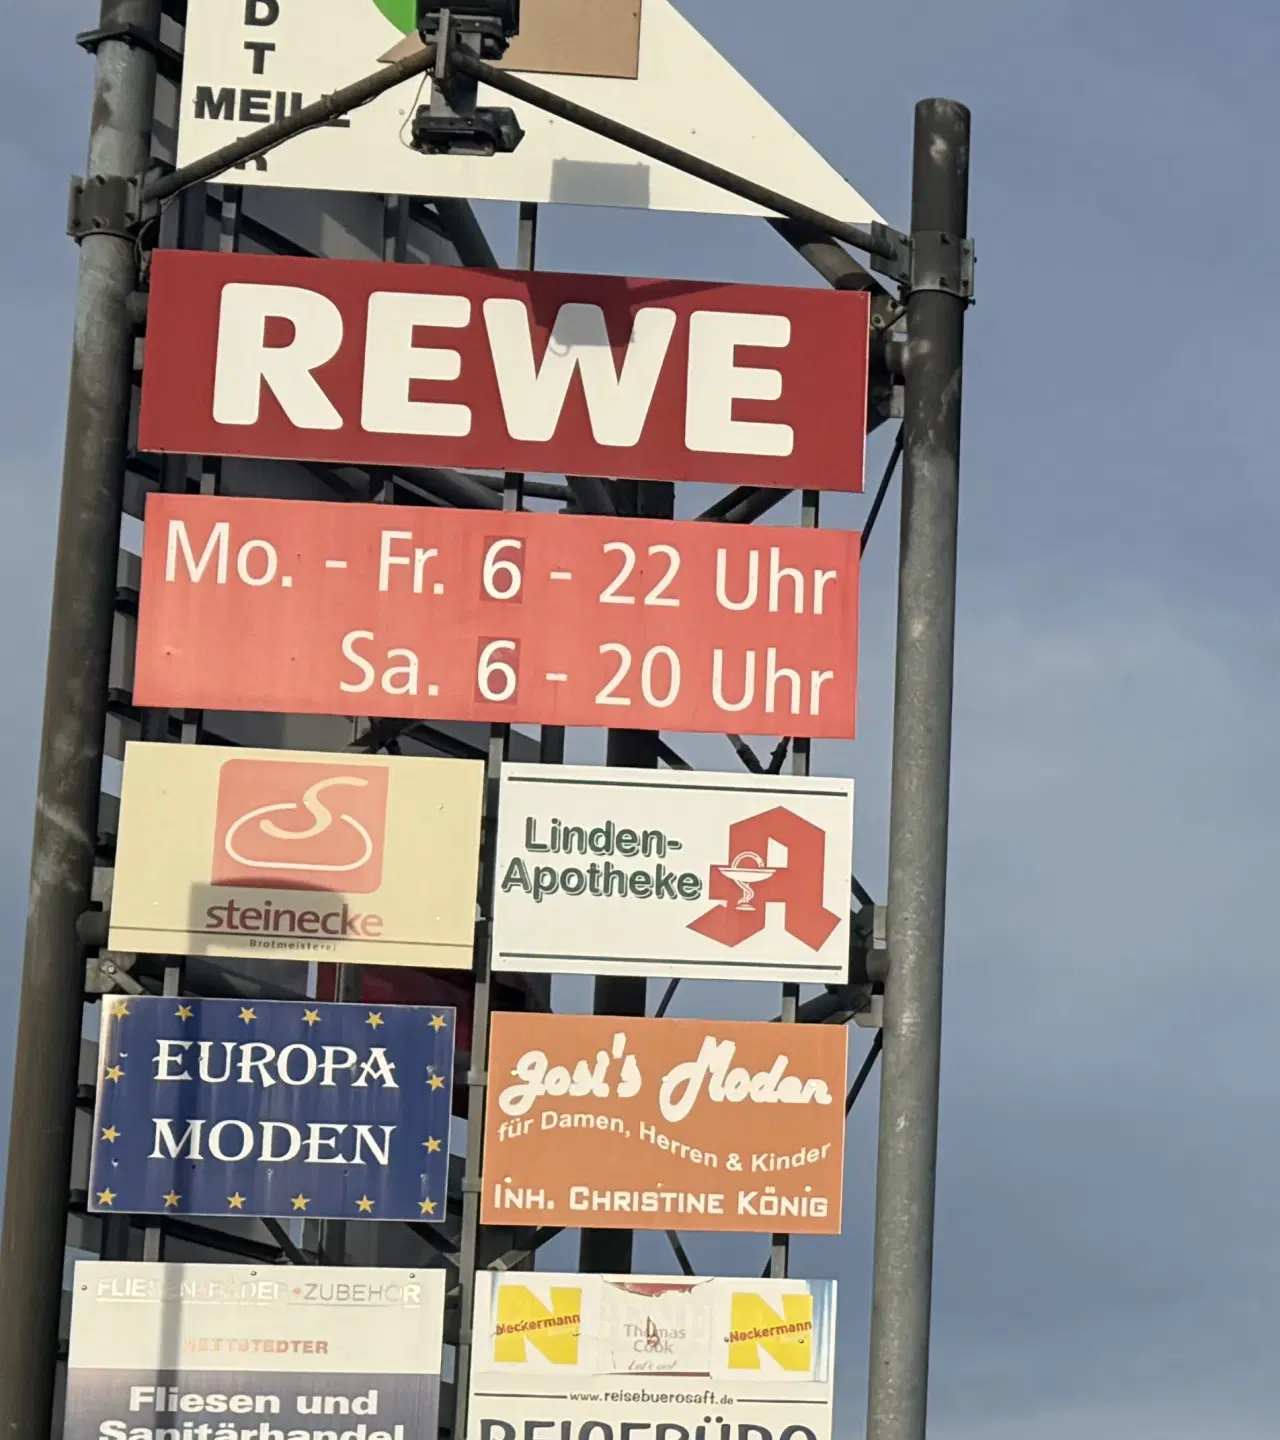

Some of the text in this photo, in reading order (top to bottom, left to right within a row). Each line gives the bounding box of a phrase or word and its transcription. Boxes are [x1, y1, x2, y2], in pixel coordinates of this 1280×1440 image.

[194, 86, 350, 128] MEIL
[212, 283, 795, 457] REWE
[164, 520, 293, 589] Mo.
[378, 530, 445, 596] Fr.
[482, 538, 522, 601] 6
[599, 541, 681, 608] 22
[714, 547, 838, 616] Uhr
[339, 631, 440, 697] Sa.
[476, 640, 517, 702] 6
[595, 644, 681, 708] 20
[712, 649, 834, 716] Uhr
[525, 816, 683, 858] Linden-
[500, 856, 703, 904] Apotheke
[205, 898, 385, 938] steinecke
[152, 1038, 400, 1088] EUROPA
[147, 1117, 397, 1165] MODEN
[497, 1110, 832, 1173] für Damen, Herren & Kinder
[729, 1319, 813, 1344] Neckermann
[129, 1386, 379, 1416] Fliesen und
[569, 1388, 735, 1406] www.reisebuerosaft.de
